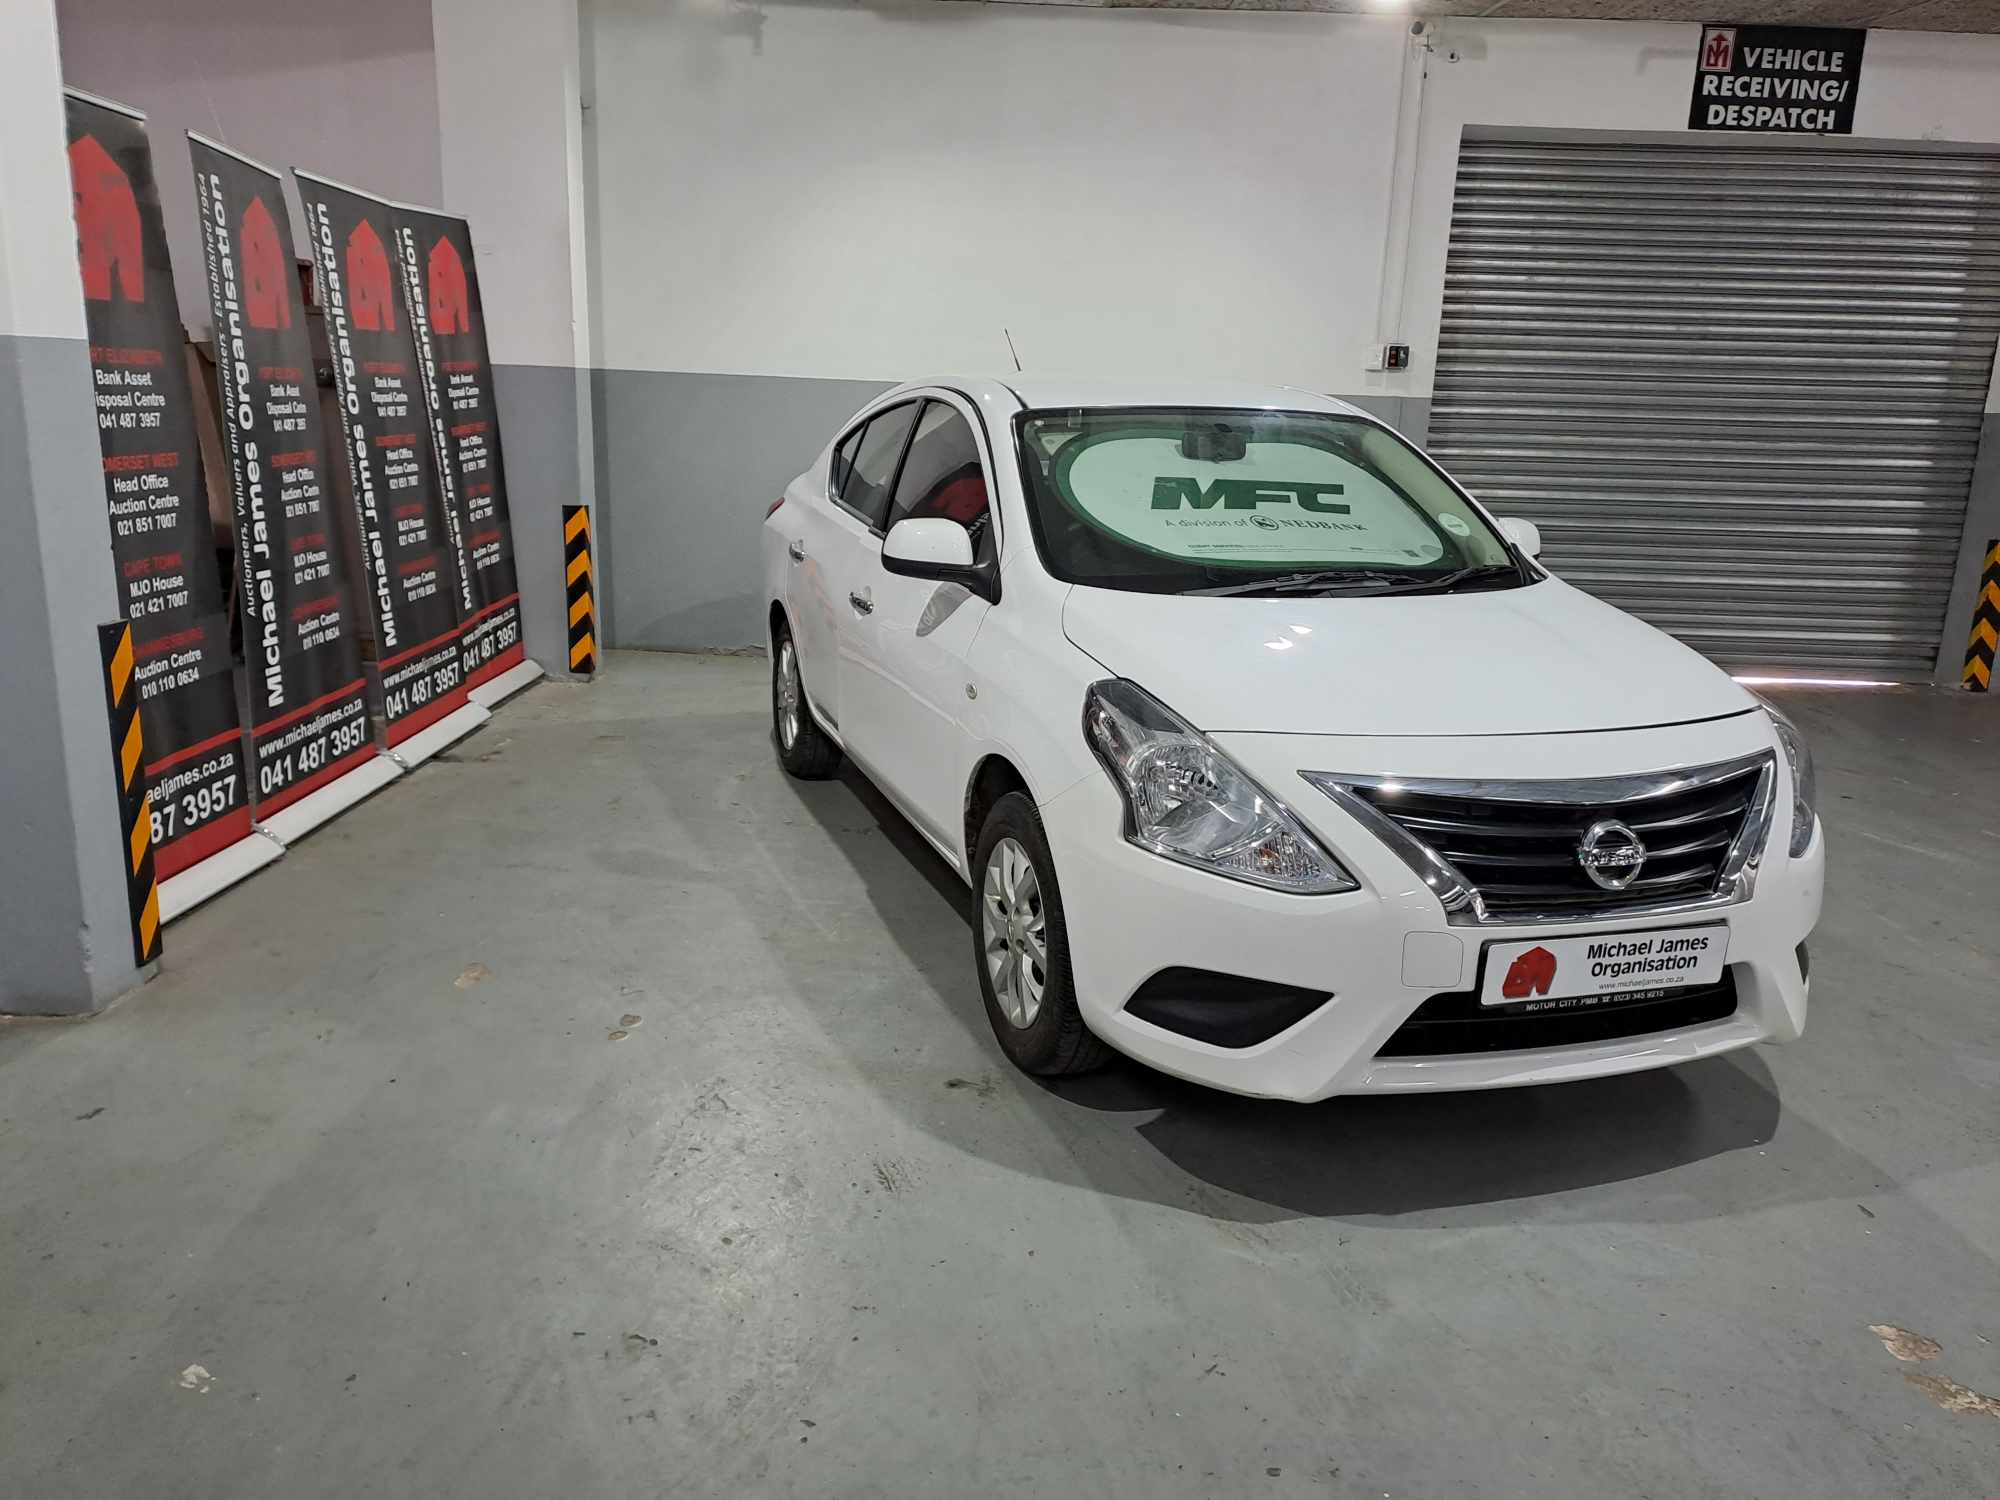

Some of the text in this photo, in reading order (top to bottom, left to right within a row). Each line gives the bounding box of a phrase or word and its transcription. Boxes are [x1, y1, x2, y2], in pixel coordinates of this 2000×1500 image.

[1743, 46, 1844, 73] VEHICLE
[1702, 74, 1849, 102] RECEIVING/
[1706, 104, 1836, 130] DESPATCH
[197, 172, 210, 215] 1964
[204, 222, 224, 318] Established
[403, 227, 440, 410] Organisation
[95, 369, 153, 386] Bank Asset
[219, 333, 236, 420] Appraisers
[134, 391, 165, 407] Centre
[99, 412, 161, 429] 041 487 3957
[317, 203, 398, 648] Michael James Organisation
[209, 174, 284, 708] Michael James Organisation
[228, 422, 239, 454] and
[435, 418, 455, 503] James
[113, 474, 169, 493] Head Office
[233, 458, 246, 517] Valuers
[1151, 476, 1351, 515] MFC
[109, 494, 179, 516] Auction Centre
[117, 517, 135, 537] 021
[135, 514, 154, 534] 851
[1165, 517, 1370, 532] A division of NEDBANK
[240, 522, 256, 617] Auctioneers,
[307, 551, 328, 565] House
[451, 510, 472, 610] Michael
[130, 575, 184, 598] MJO House
[130, 603, 146, 619] 021
[147, 597, 165, 614] 421
[462, 621, 518, 673] 041 487 3957
[134, 649, 202, 682] Auction Centre
[383, 646, 457, 689] www.michaeljames.co.za
[142, 667, 200, 700] 010 110 0634
[385, 661, 459, 719] 041 487 3957
[259, 697, 363, 759] www.michaeljames.co.za
[260, 717, 366, 794] 041 487 3957
[182, 774, 238, 827] 3957
[1587, 935, 1709, 961] Michael James
[1591, 954, 1698, 980] Organisation
[1598, 976, 1685, 990] www.michaeljames.co.za
[1525, 1002, 1557, 1012] MOTOR
[1559, 999, 1577, 1008] CITY
